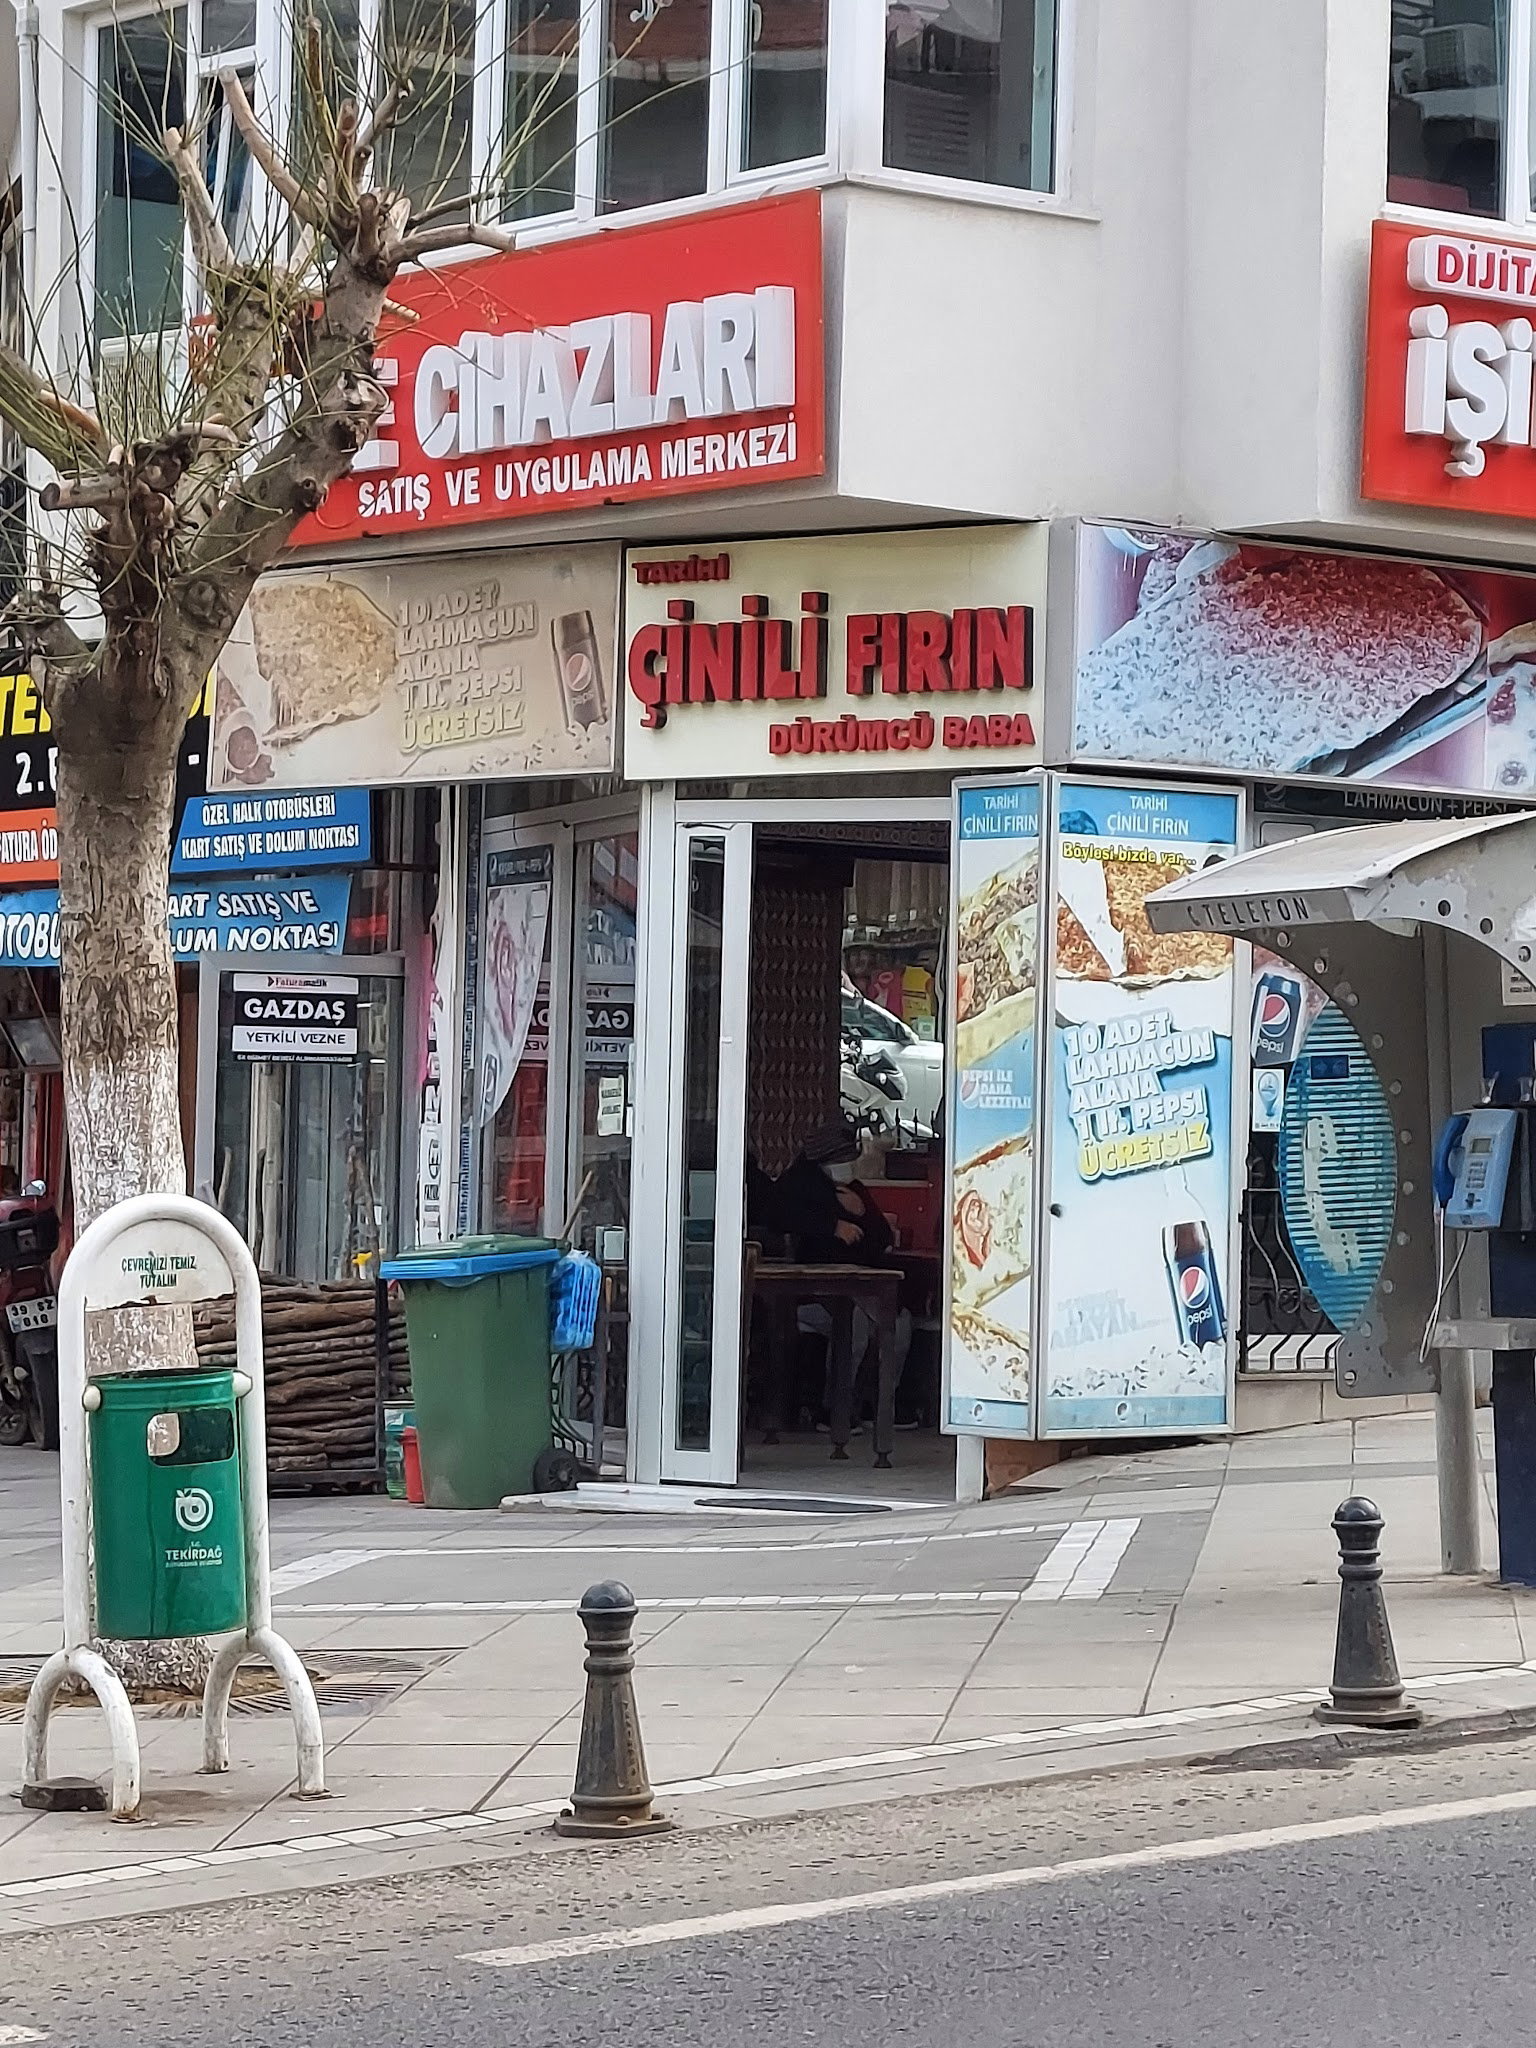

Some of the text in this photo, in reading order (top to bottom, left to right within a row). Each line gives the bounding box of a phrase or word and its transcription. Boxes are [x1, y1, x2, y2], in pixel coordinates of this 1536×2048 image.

[1438, 244, 1536, 296] DİJİT
[413, 284, 796, 460] CİHAZLARI
[1405, 303, 1536, 478] İŞİ
[358, 412, 797, 521] SATIŞ VE UYGULAMA MERKEZİ
[632, 553, 730, 585] TARİHİ
[434, 580, 500, 623] ADET
[397, 603, 536, 656] LAHMACUN
[397, 644, 481, 685] ALANA
[628, 591, 1034, 730] ÇİNİLİ FIRIN
[769, 710, 1036, 755] DÜRÜMCÜ BABA
[203, 797, 230, 826] ÖZEL
[233, 801, 263, 824] HALK
[983, 792, 1019, 810] TARİHİ
[1129, 794, 1168, 812] TARİHİ
[963, 812, 1038, 838] ÇİNİLİ FIRIN
[1107, 811, 1190, 836] ÇİNİLİ FIRIN
[0, 829, 38, 864] ATURA
[182, 824, 359, 861] KART SATIŞ VE DOLUM NOKTASI
[1062, 841, 1115, 863] Böylesi
[1118, 845, 1156, 864] bizde
[168, 889, 319, 921] ART SATIŞ VE
[1201, 896, 1310, 926] TELEFON
[226, 921, 340, 952] NOKTASI
[243, 997, 346, 1026] GAZDAŞ
[246, 1030, 346, 1045] YETKİLİ VEZNE
[1067, 1010, 1171, 1057] 10 ADET
[1067, 1031, 1214, 1085] LAHMACUN
[1071, 1073, 1160, 1114] ALANA
[1132, 1087, 1205, 1129] PEPSI
[1080, 1119, 1209, 1177] ÜCRETSİZ
[121, 1252, 197, 1275] ÇEVREMİZİ TEMİZ
[140, 1273, 177, 1288] TUTALIM
[1187, 1304, 1213, 1327] pepsi
[165, 1545, 223, 1561] TEKİRDAĞ
